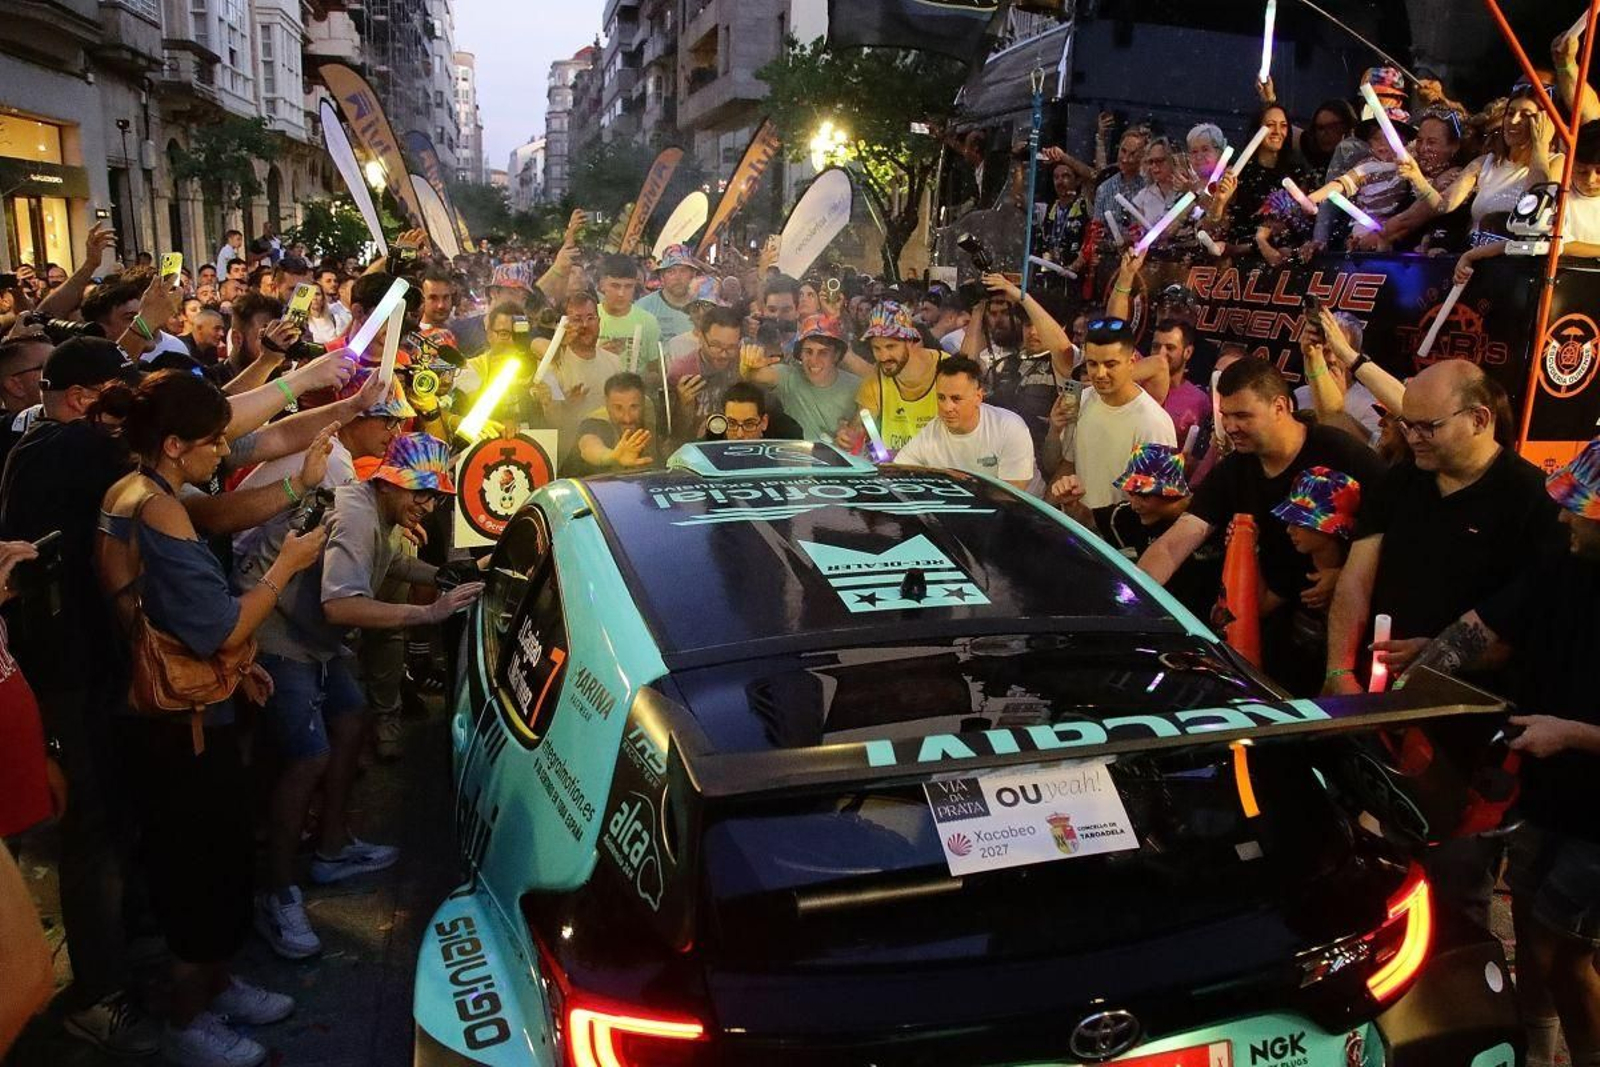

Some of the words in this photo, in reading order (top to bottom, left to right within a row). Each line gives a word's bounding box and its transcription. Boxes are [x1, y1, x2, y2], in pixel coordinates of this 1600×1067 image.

[1186, 266, 1387, 313] RALLYE
[652, 482, 976, 509] RecOficial
[827, 558, 945, 572] REC-DEALER
[529, 646, 566, 728] 7
[573, 662, 617, 721] MARINA
[937, 778, 969, 794] VIA
[995, 783, 1043, 807] OU
[1044, 771, 1102, 803] yeah!
[936, 801, 986, 818] PRATA
[608, 801, 650, 868] alca
[973, 823, 1036, 844] Xacobeo
[1079, 828, 1126, 841] TABOADELA
[980, 843, 1009, 859] 2027
[1249, 1030, 1308, 1066] NGK
